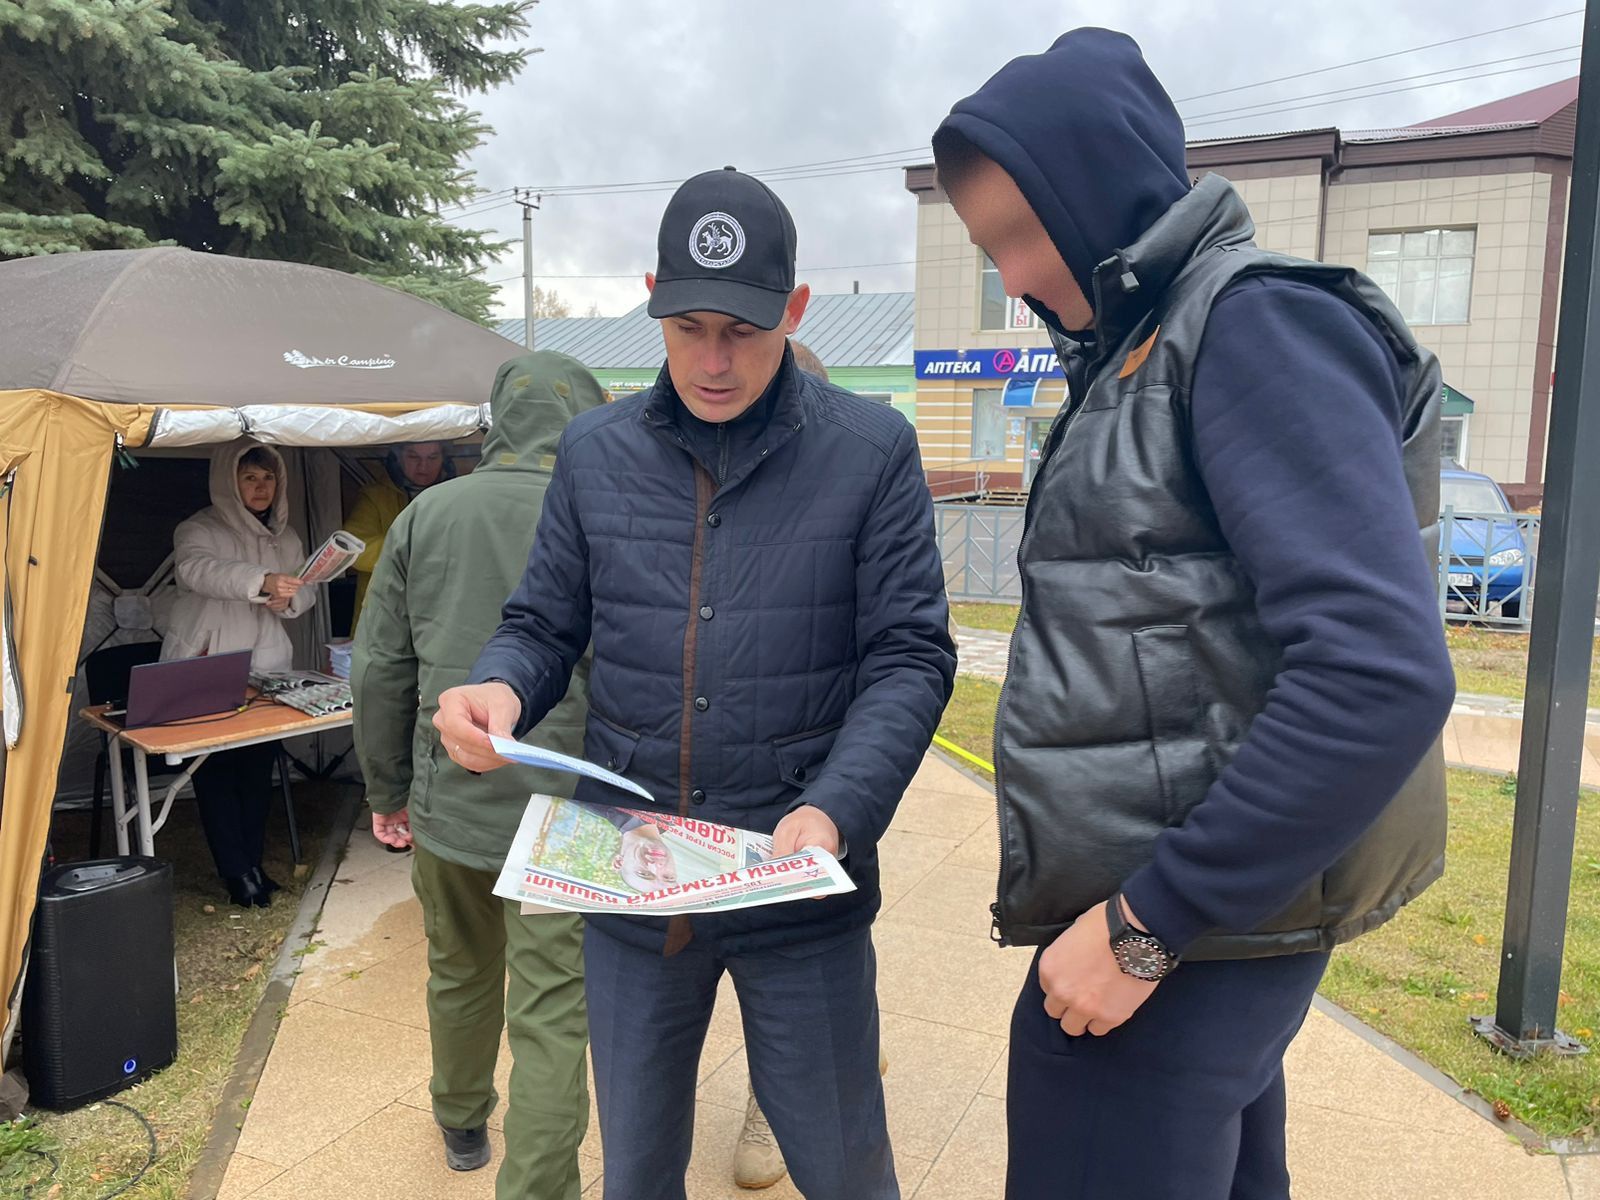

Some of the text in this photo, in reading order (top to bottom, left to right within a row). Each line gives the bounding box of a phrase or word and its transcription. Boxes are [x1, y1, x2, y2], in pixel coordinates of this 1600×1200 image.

[338, 355, 397, 367] Camping
[924, 361, 982, 374] АПТЕКА
[707, 843, 736, 860] РОССИЯ
[747, 856, 820, 880] ХӘРБИ
[525, 873, 618, 904] КУШЫЛ!
